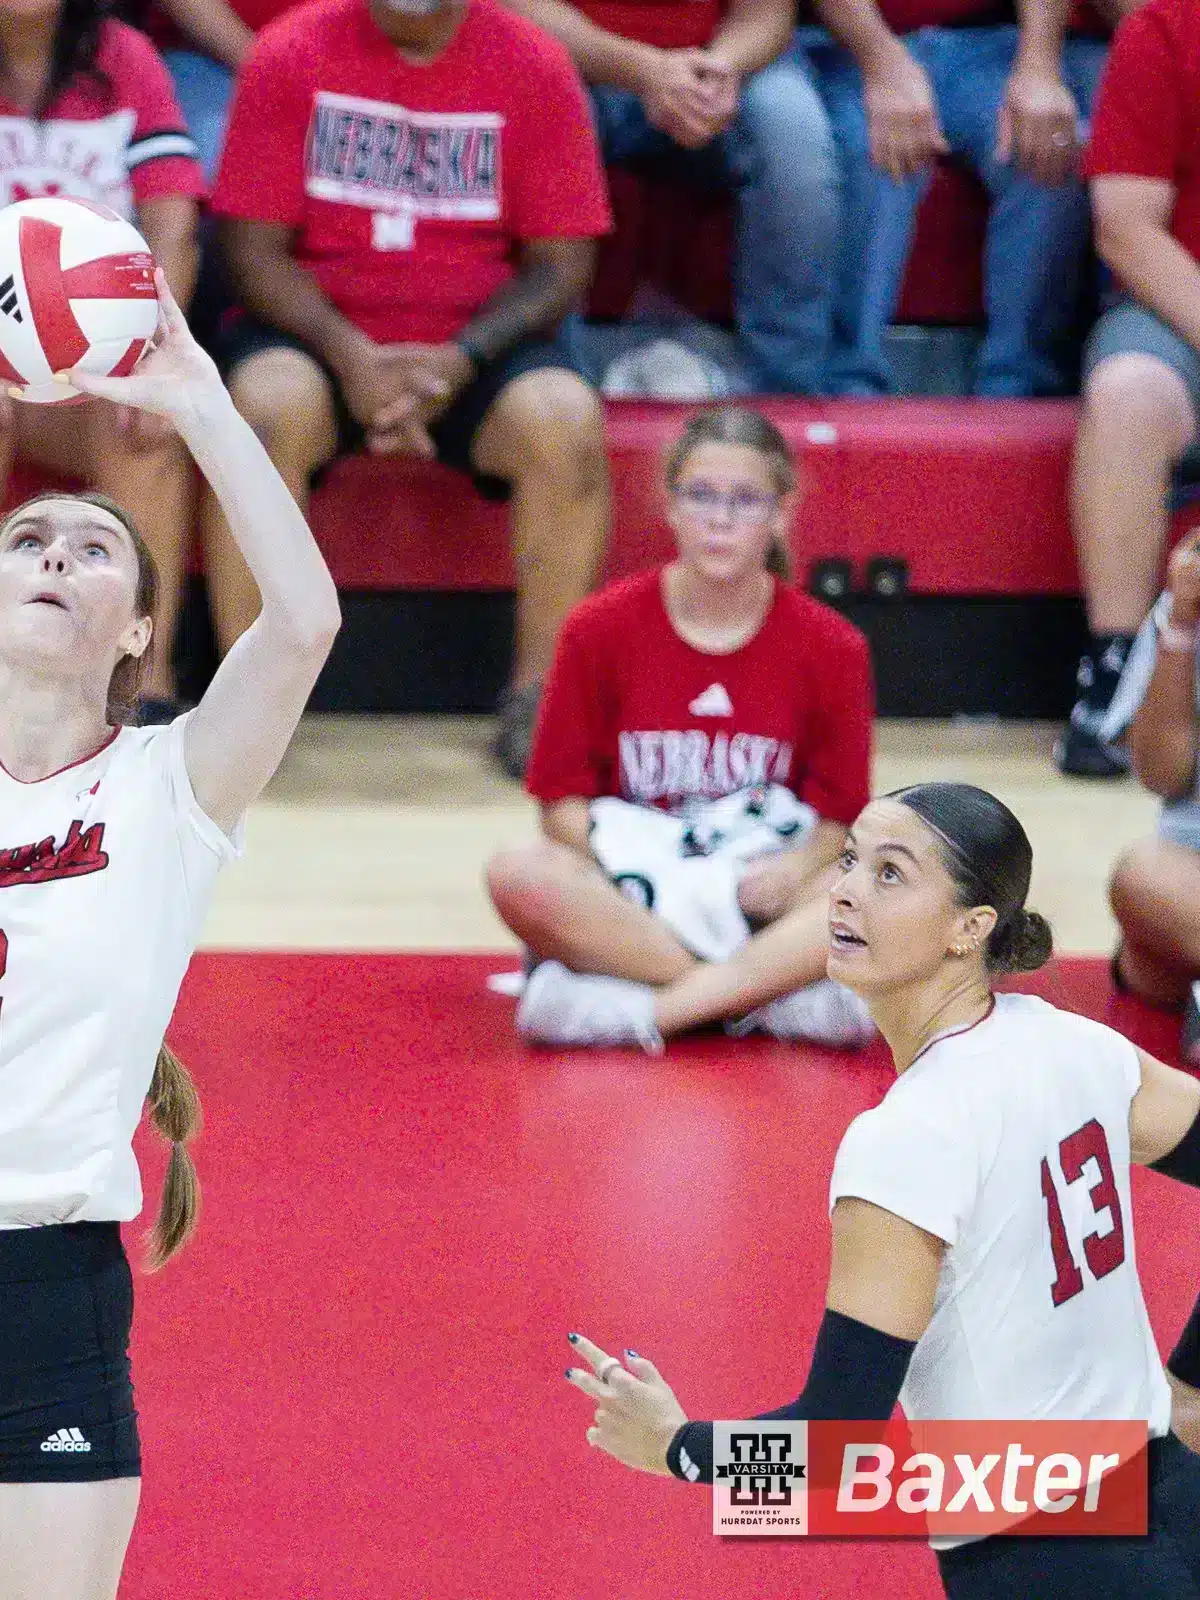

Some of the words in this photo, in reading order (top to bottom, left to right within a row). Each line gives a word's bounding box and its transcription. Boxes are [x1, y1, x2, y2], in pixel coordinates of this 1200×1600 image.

[310, 104, 499, 198] NEBRASKA
[1040, 1117, 1125, 1308] 13
[40, 1439, 92, 1453] adidas
